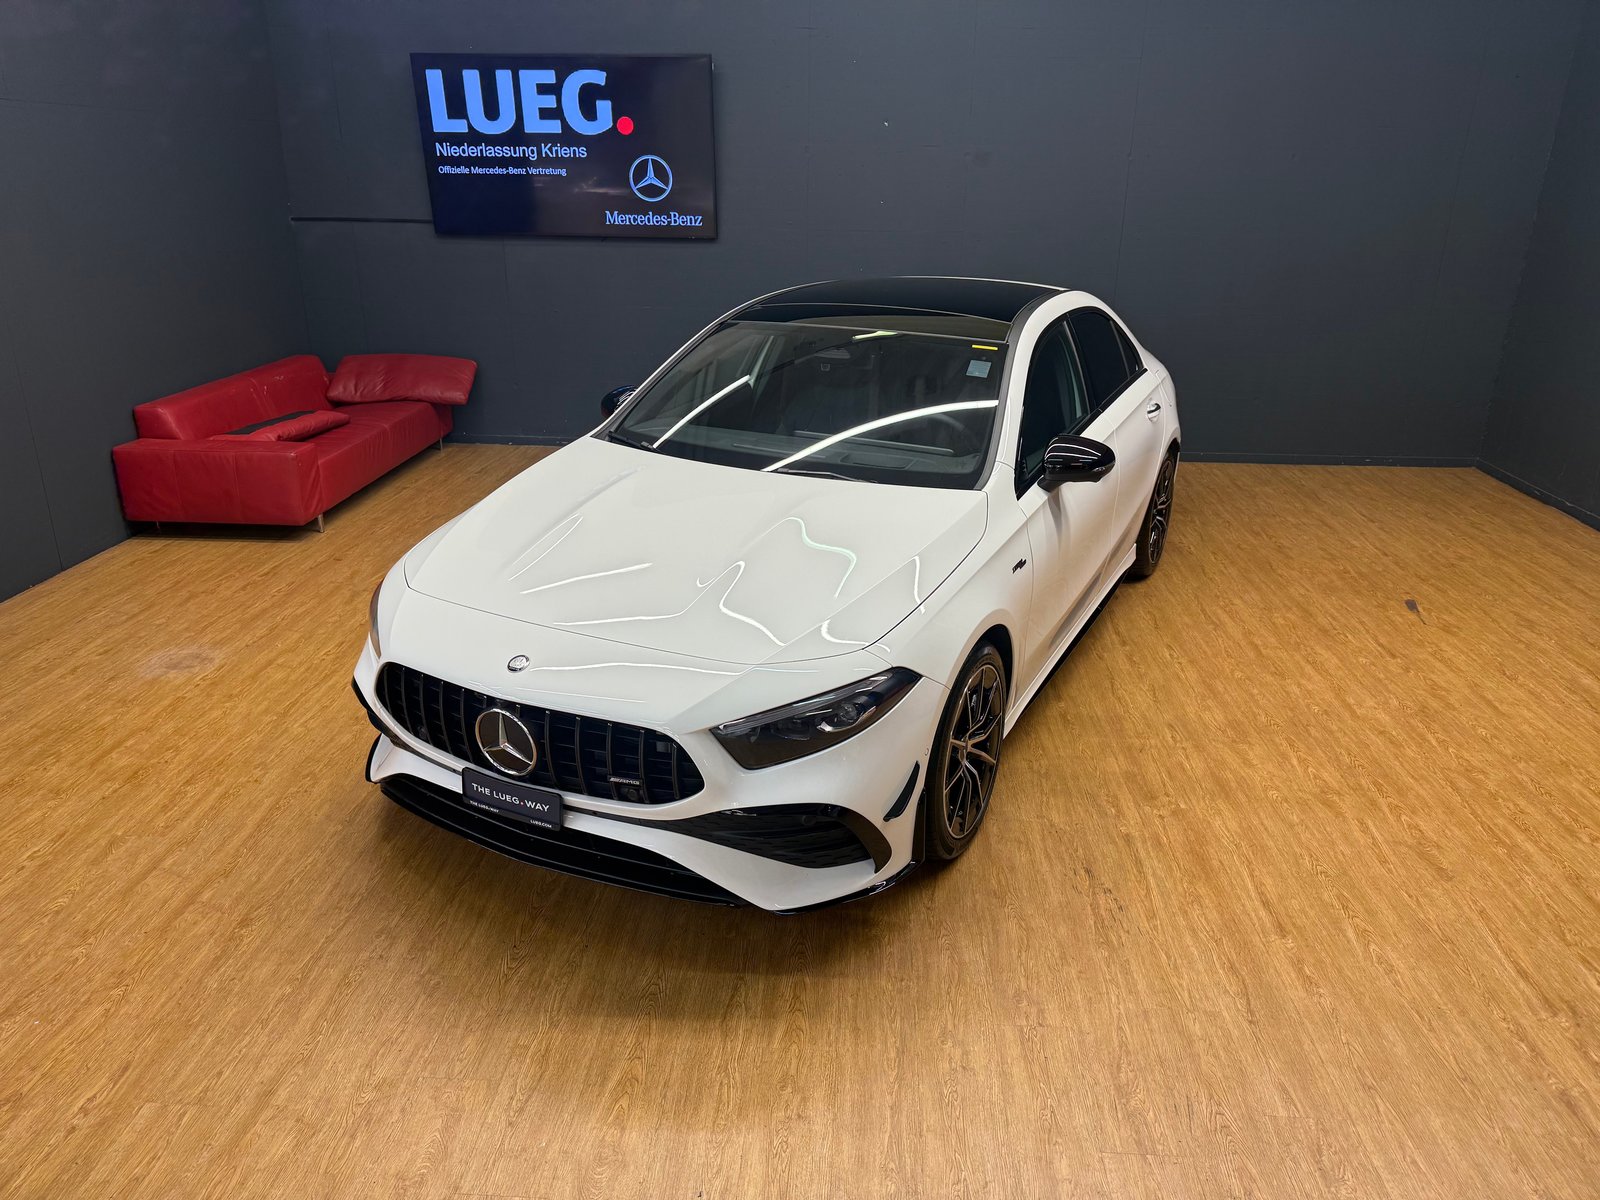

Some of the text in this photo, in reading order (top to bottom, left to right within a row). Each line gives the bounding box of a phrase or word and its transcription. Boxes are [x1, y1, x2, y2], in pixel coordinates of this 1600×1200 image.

[435, 142, 588, 161] Niederlassung Kriens
[438, 165, 567, 176] Offizielle Mercedes-Benz Vertretung
[604, 210, 703, 227] Mercedes-Benz
[471, 782, 491, 796] THE
